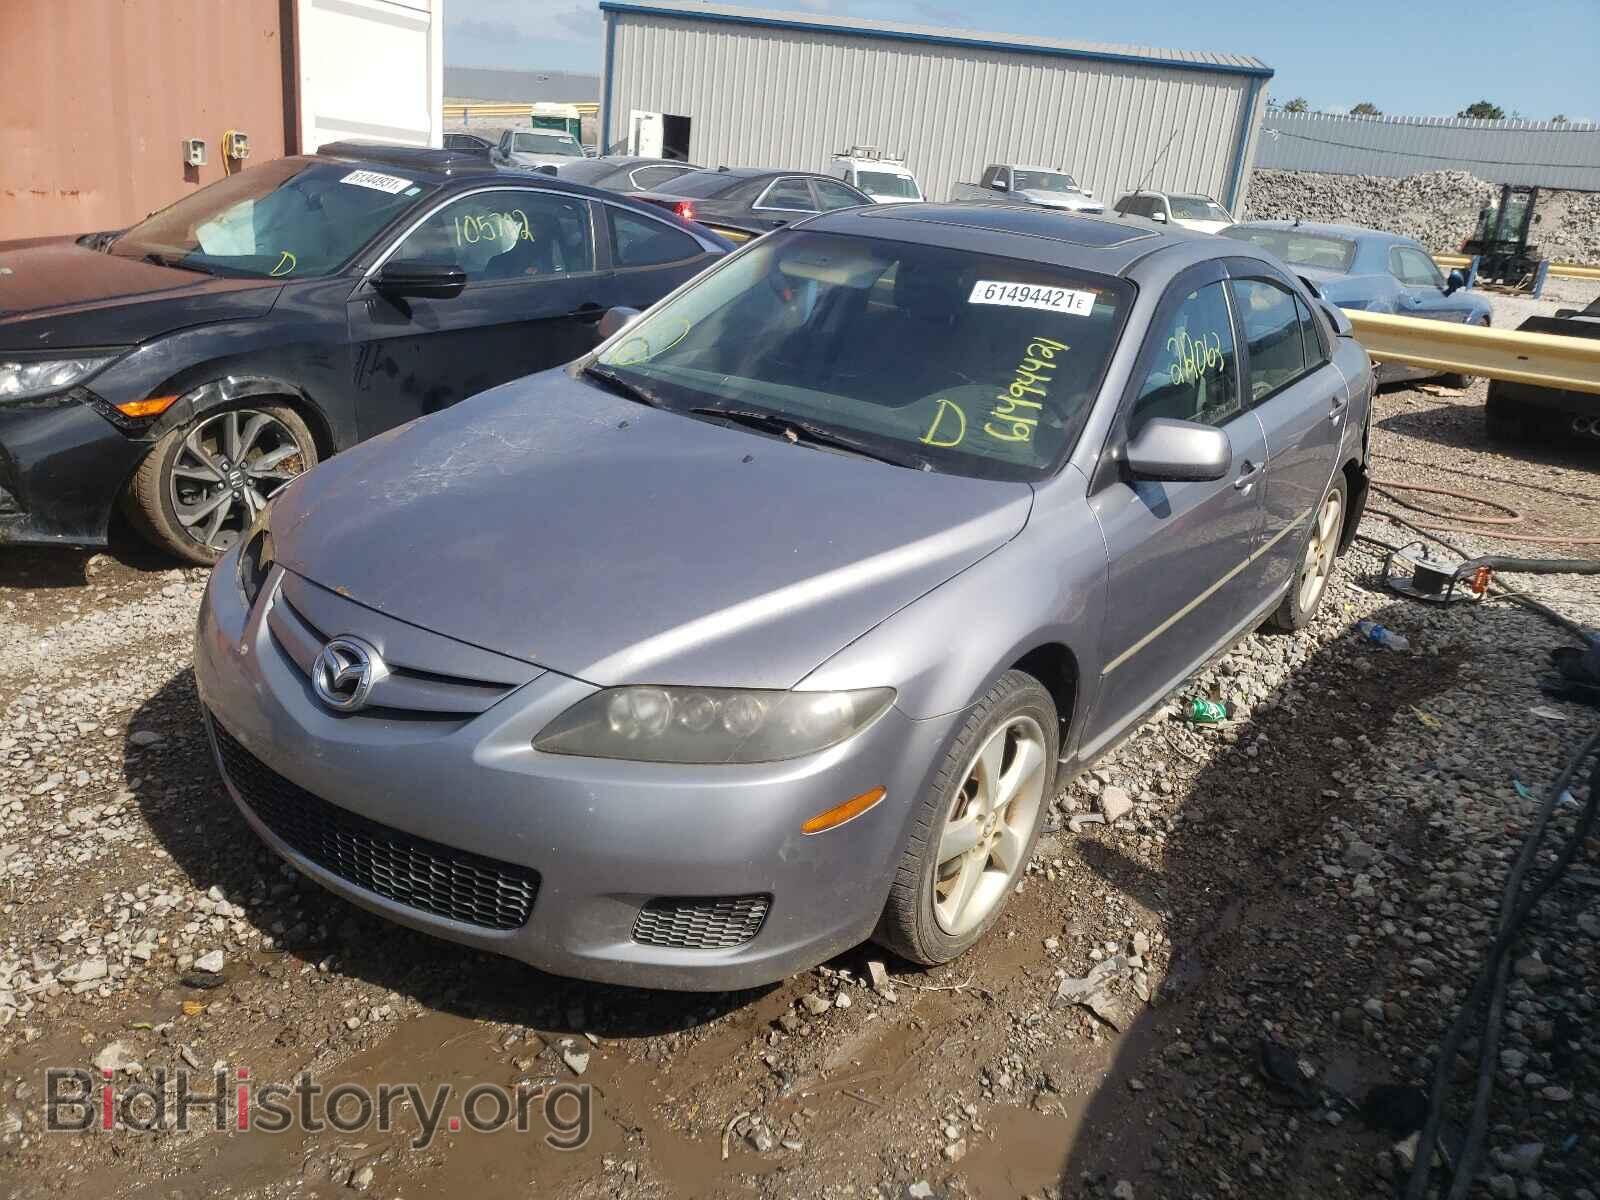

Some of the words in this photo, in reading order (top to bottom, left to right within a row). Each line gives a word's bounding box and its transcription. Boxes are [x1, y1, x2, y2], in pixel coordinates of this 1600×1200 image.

[270, 250, 297, 277] D
[983, 336, 1071, 442] 61494421
[918, 399, 967, 447] D
